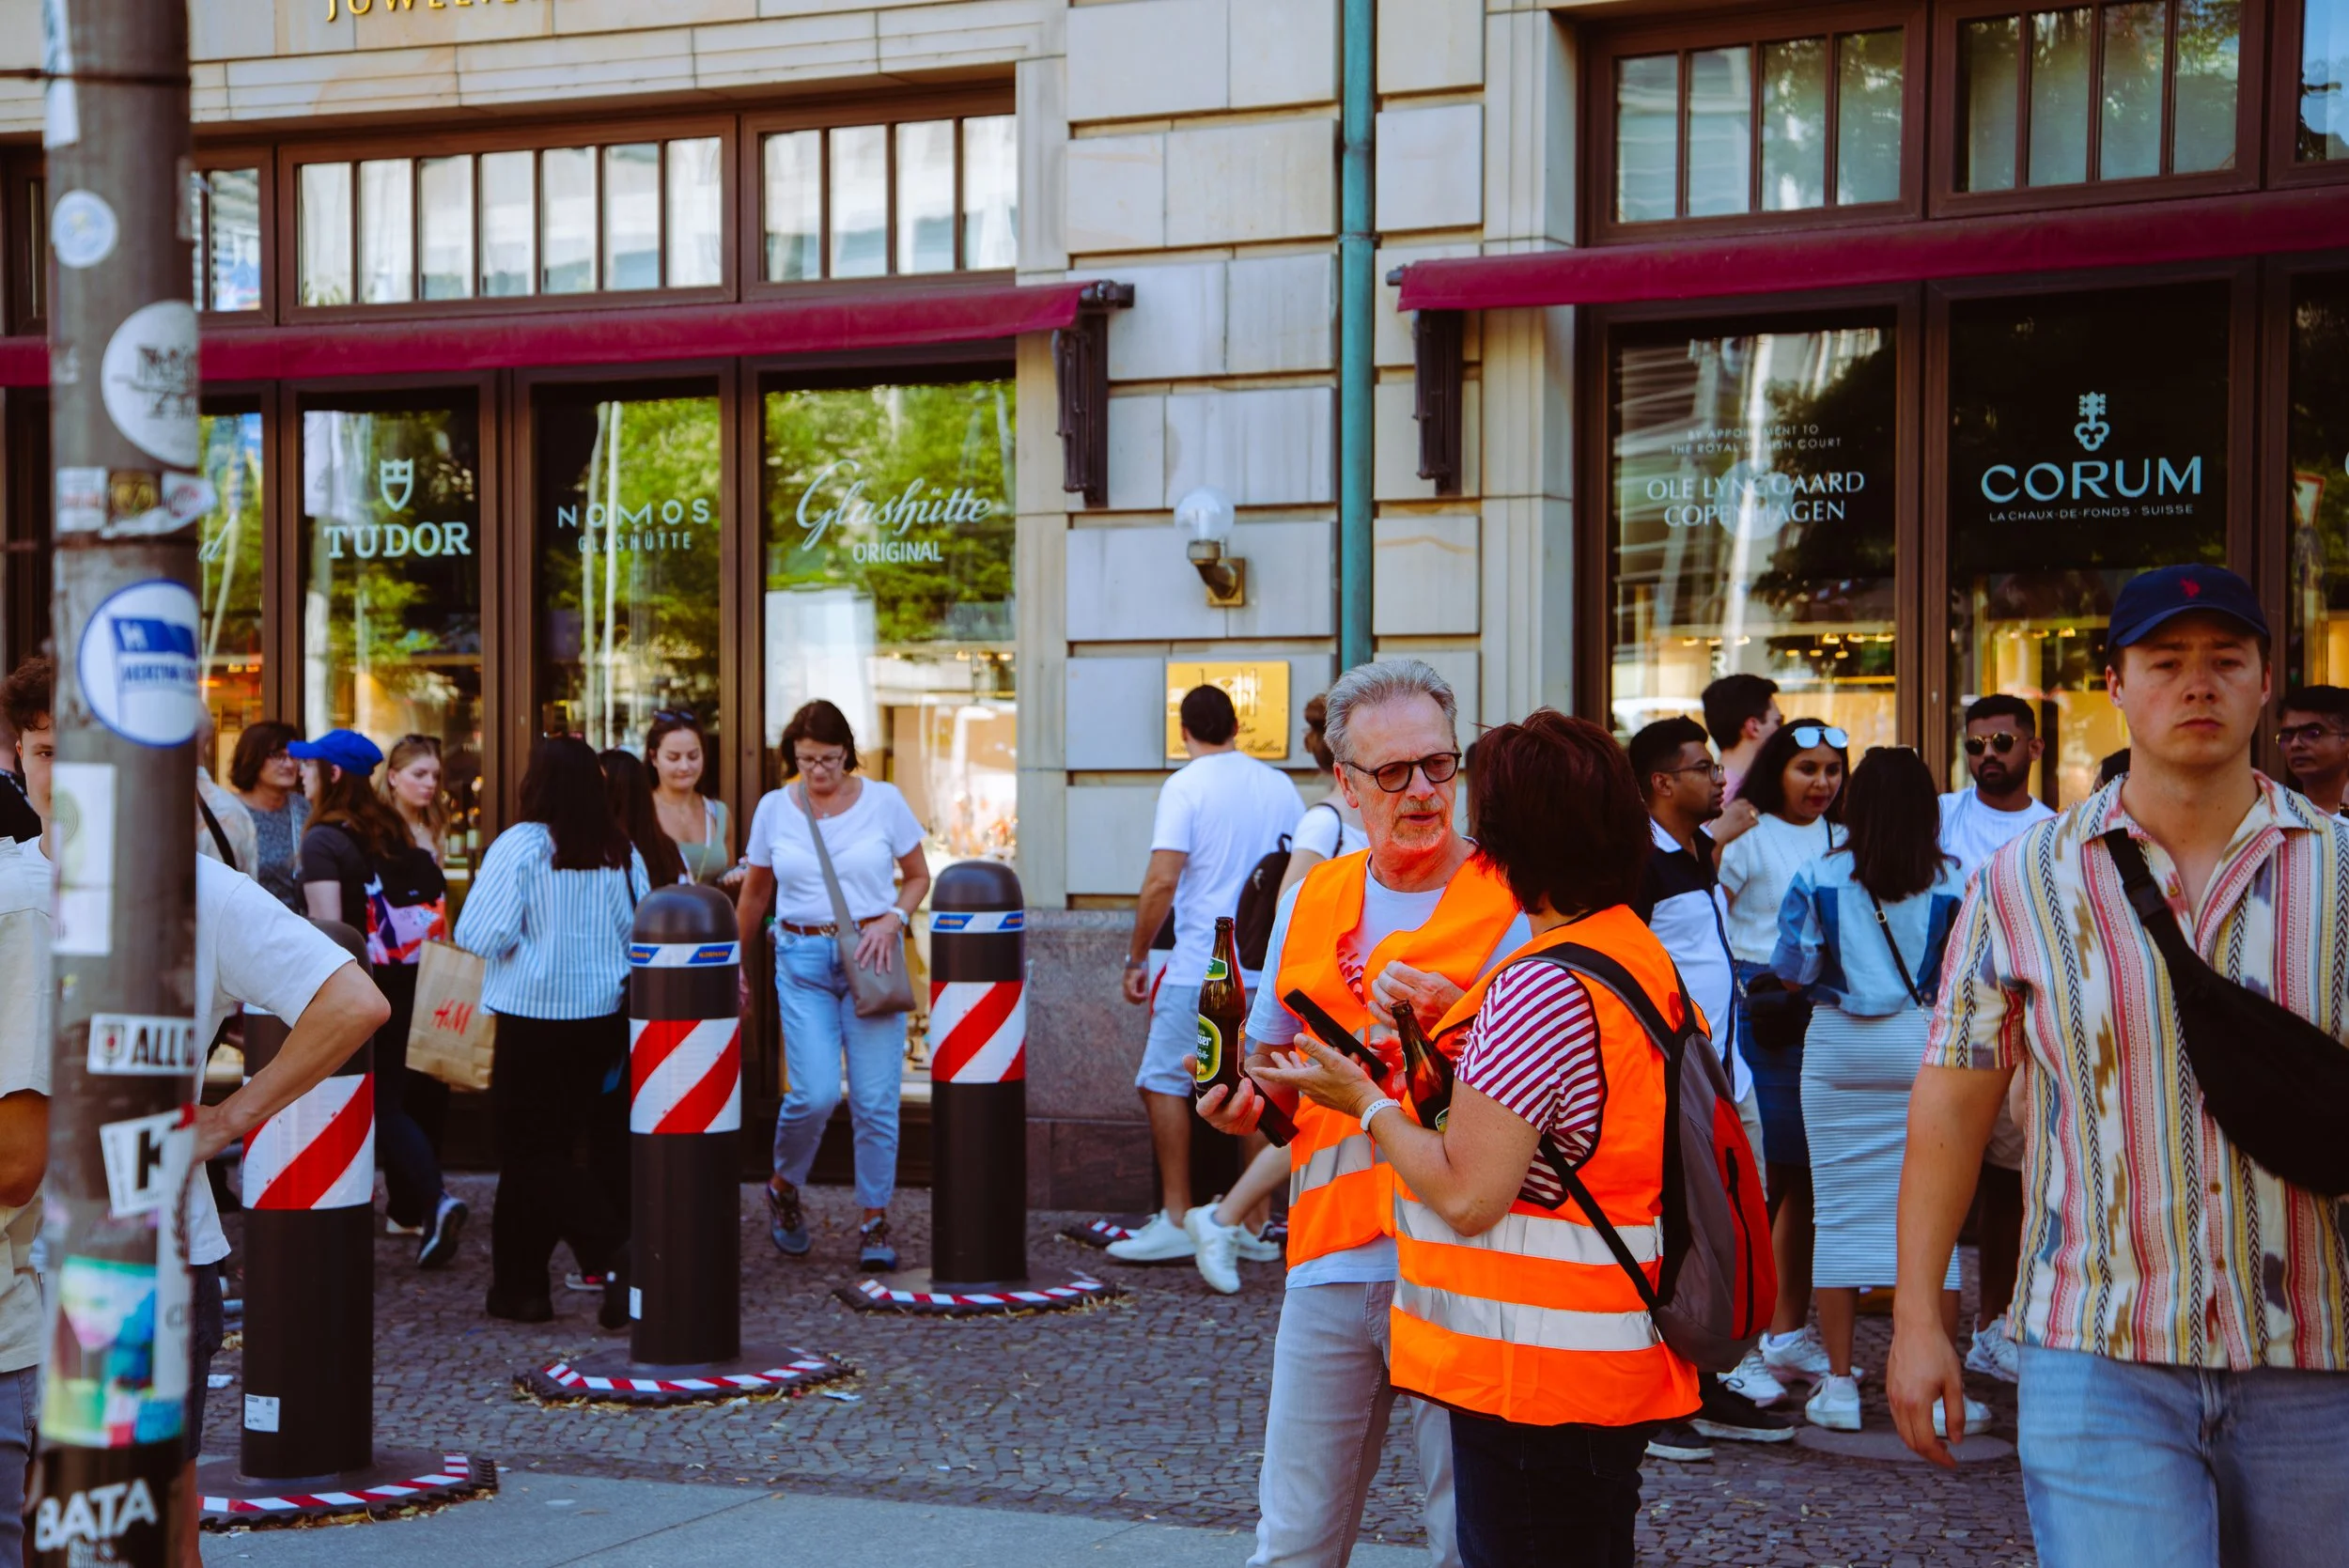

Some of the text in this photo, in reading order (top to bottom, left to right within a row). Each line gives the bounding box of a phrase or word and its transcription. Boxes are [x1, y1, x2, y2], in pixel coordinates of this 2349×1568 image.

[1671, 437, 1842, 455] THE ROYAL DNISH COURT
[1688, 424, 1819, 441] BY APPOIMENT TO
[1646, 471, 1865, 501] OLE LYNGGAARD
[1981, 456, 2201, 504] CORUM
[557, 498, 710, 529] NOMOS
[796, 458, 991, 551] Glashütte
[1664, 499, 1845, 527] COPENHAGEN
[1989, 512, 2006, 522] LA
[2141, 504, 2194, 516] SUISSE
[323, 521, 472, 559] TUDOR
[852, 540, 944, 564] ORIGINAL
[34, 1476, 159, 1552] BATA
